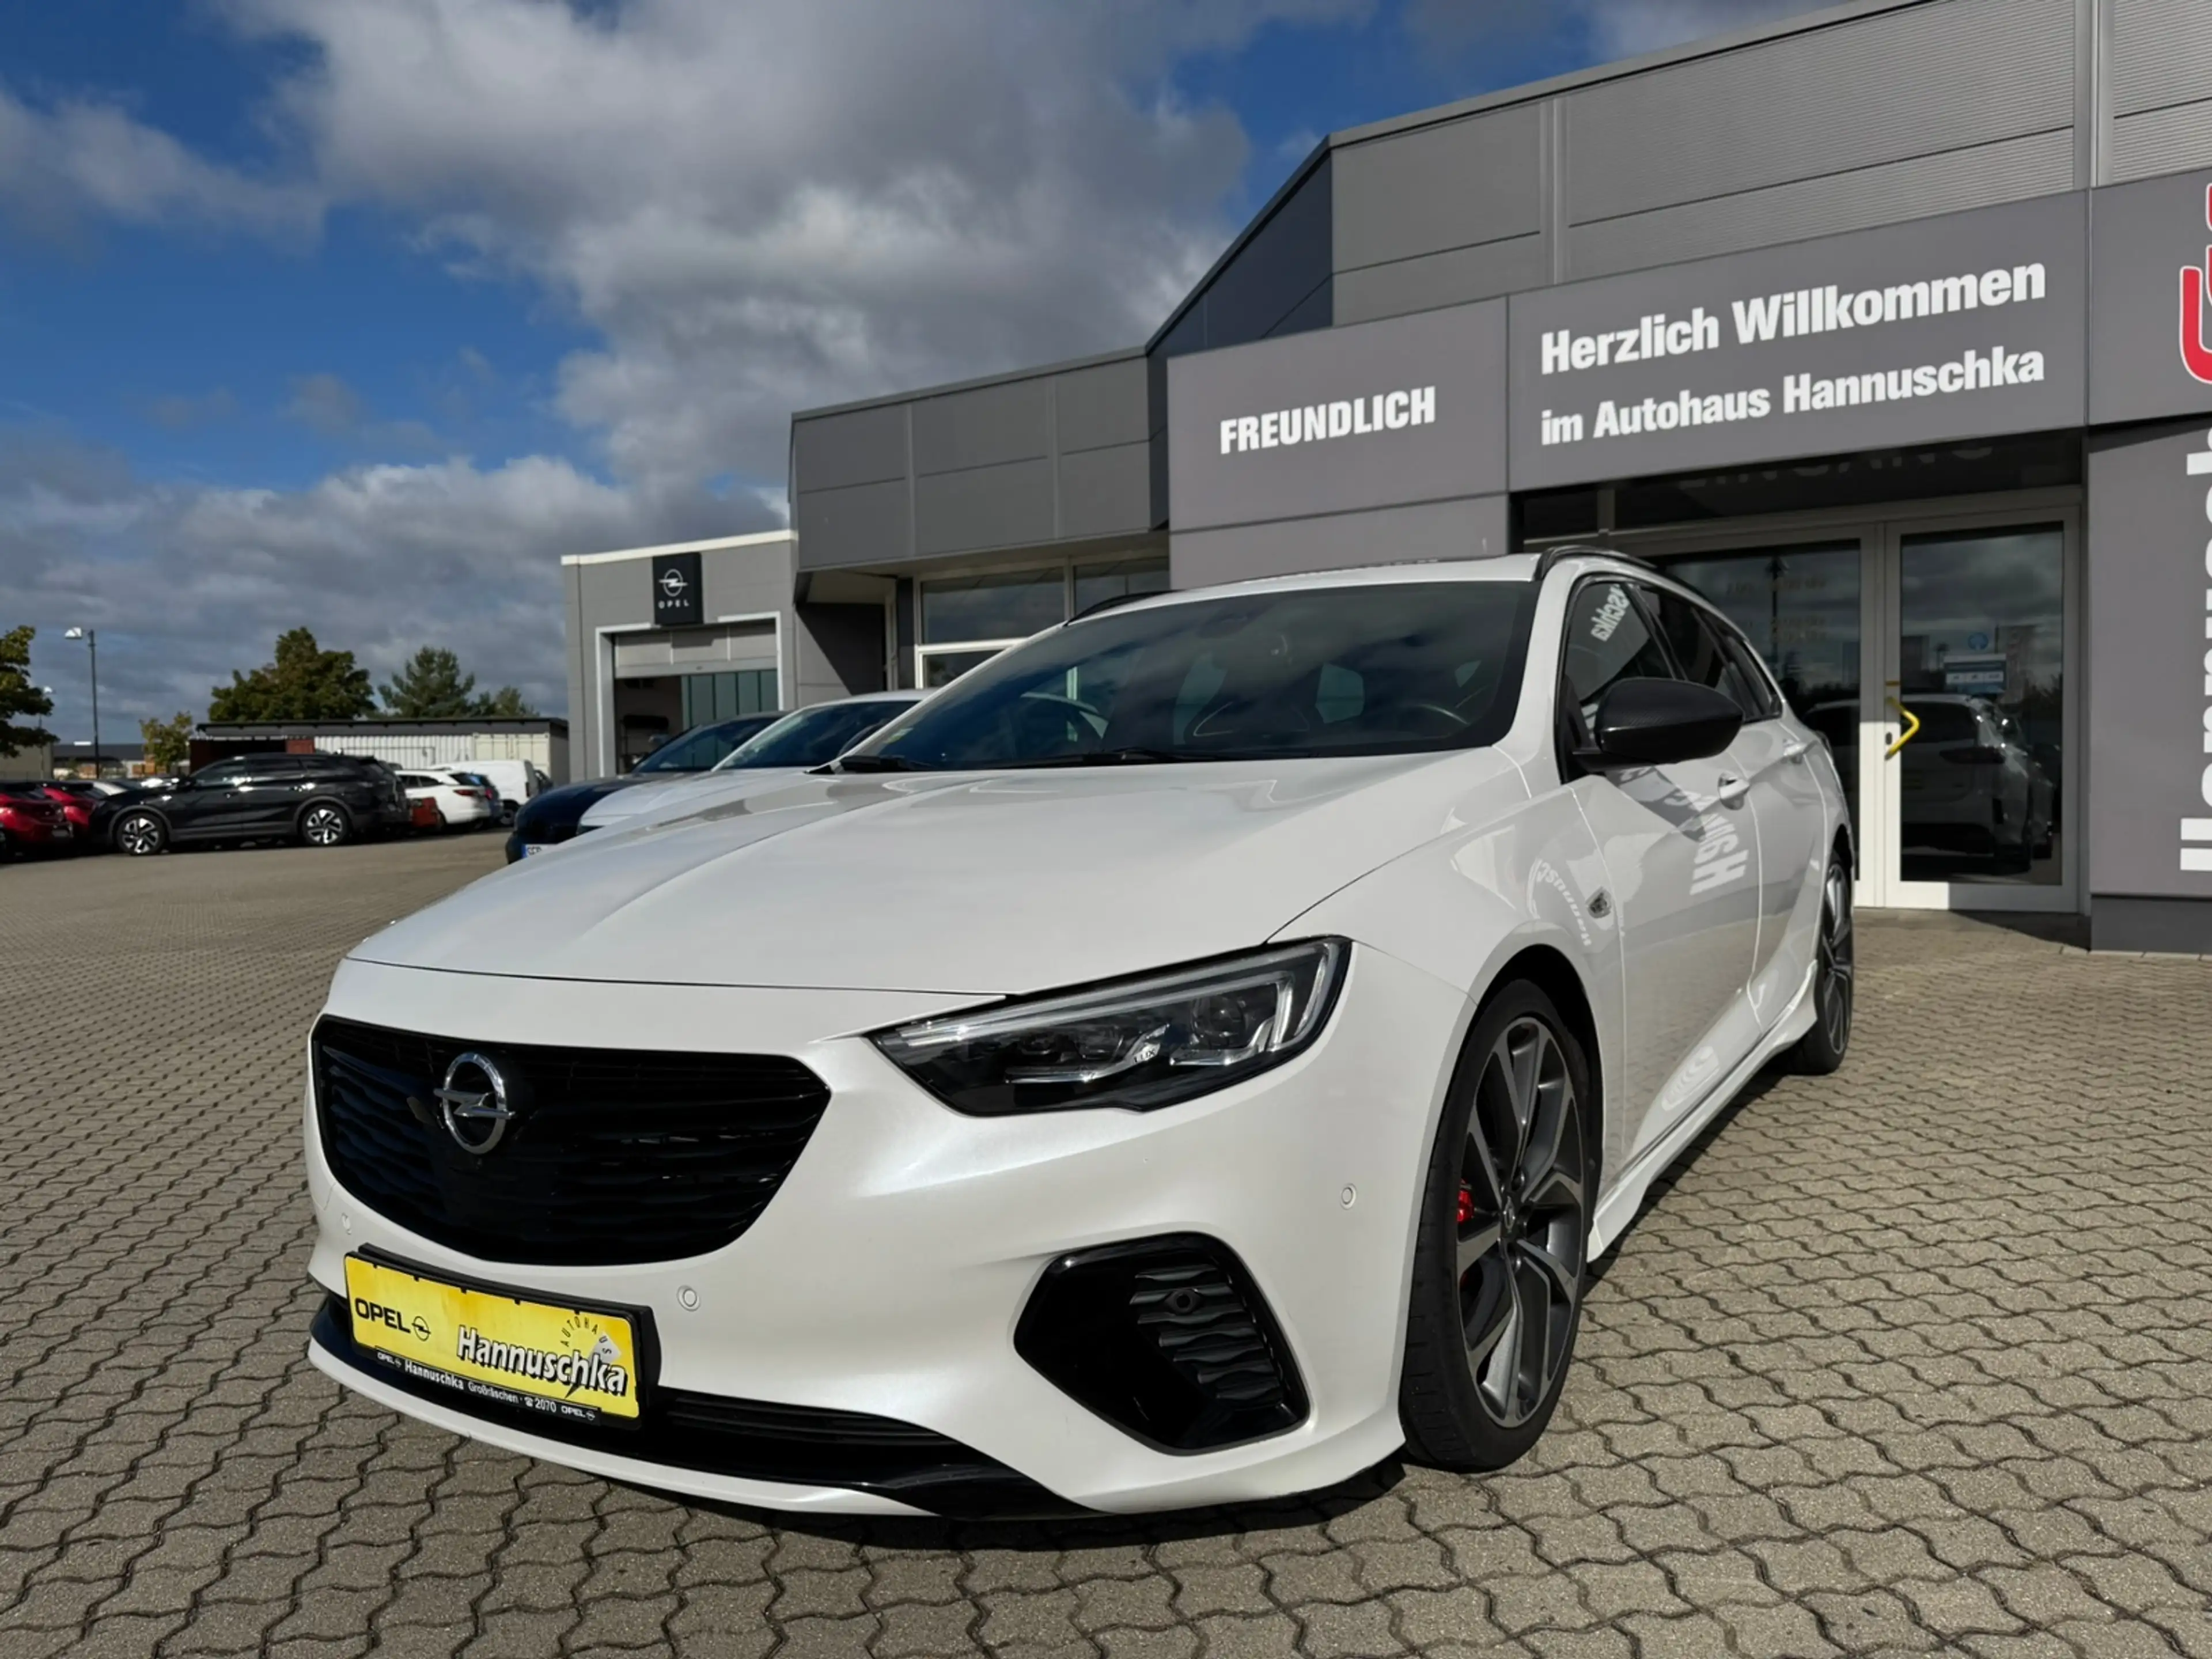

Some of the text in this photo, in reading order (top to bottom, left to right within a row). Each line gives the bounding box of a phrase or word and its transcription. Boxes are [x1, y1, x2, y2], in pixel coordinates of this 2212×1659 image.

[1541, 263, 2046, 374] Herzlich Willkommen
[1220, 386, 1435, 454] FREUNDLICH
[1541, 346, 2044, 445] im Autohaus Hannuschka
[657, 599, 690, 609] OPEL
[355, 1298, 411, 1334] OPEL
[560, 1316, 612, 1354] AUTOHAUS
[377, 1352, 395, 1365] OPEL
[404, 1359, 464, 1391] Hannuschka
[535, 1398, 557, 1413] 2070
[560, 1405, 586, 1419] OPEL
[456, 1324, 628, 1397] Hannuschka
